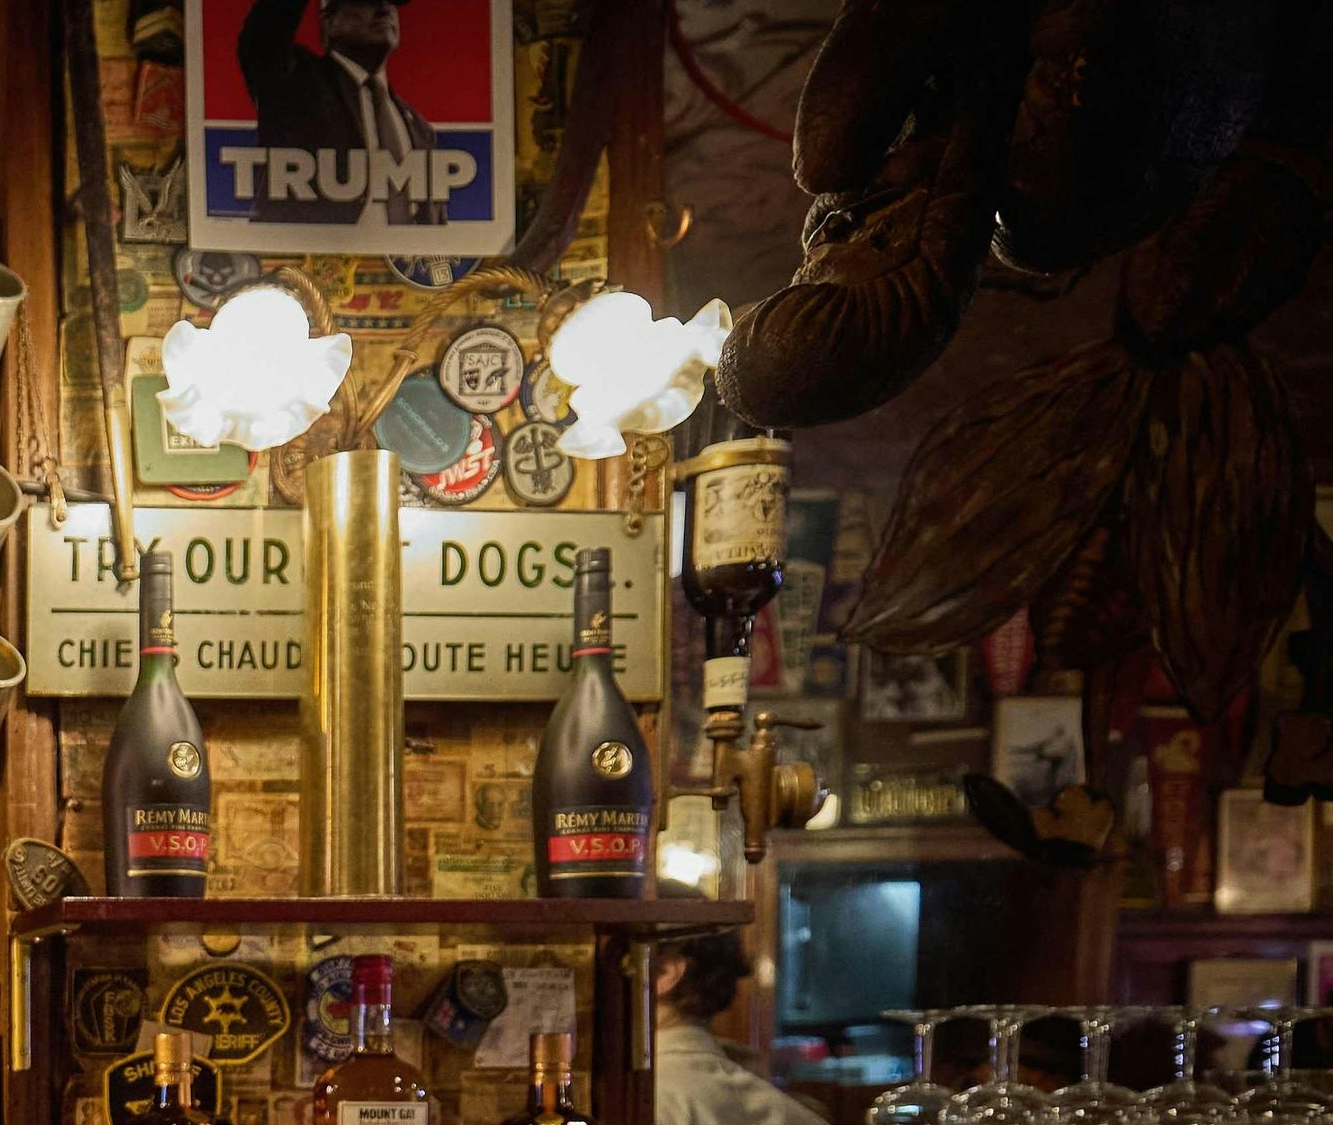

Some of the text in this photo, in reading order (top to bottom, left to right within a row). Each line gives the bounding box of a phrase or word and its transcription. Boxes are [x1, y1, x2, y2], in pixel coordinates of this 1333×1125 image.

[218, 145, 479, 202] TRUMP
[185, 536, 291, 586] OUR
[402, 642, 627, 673] OUTE HEUE
[135, 808, 175, 826] RÉMY
[554, 809, 599, 829] RÉMY
[167, 970, 285, 1026] LOS ANGELES COUNTY
[359, 1107, 398, 1120] MOUNT
